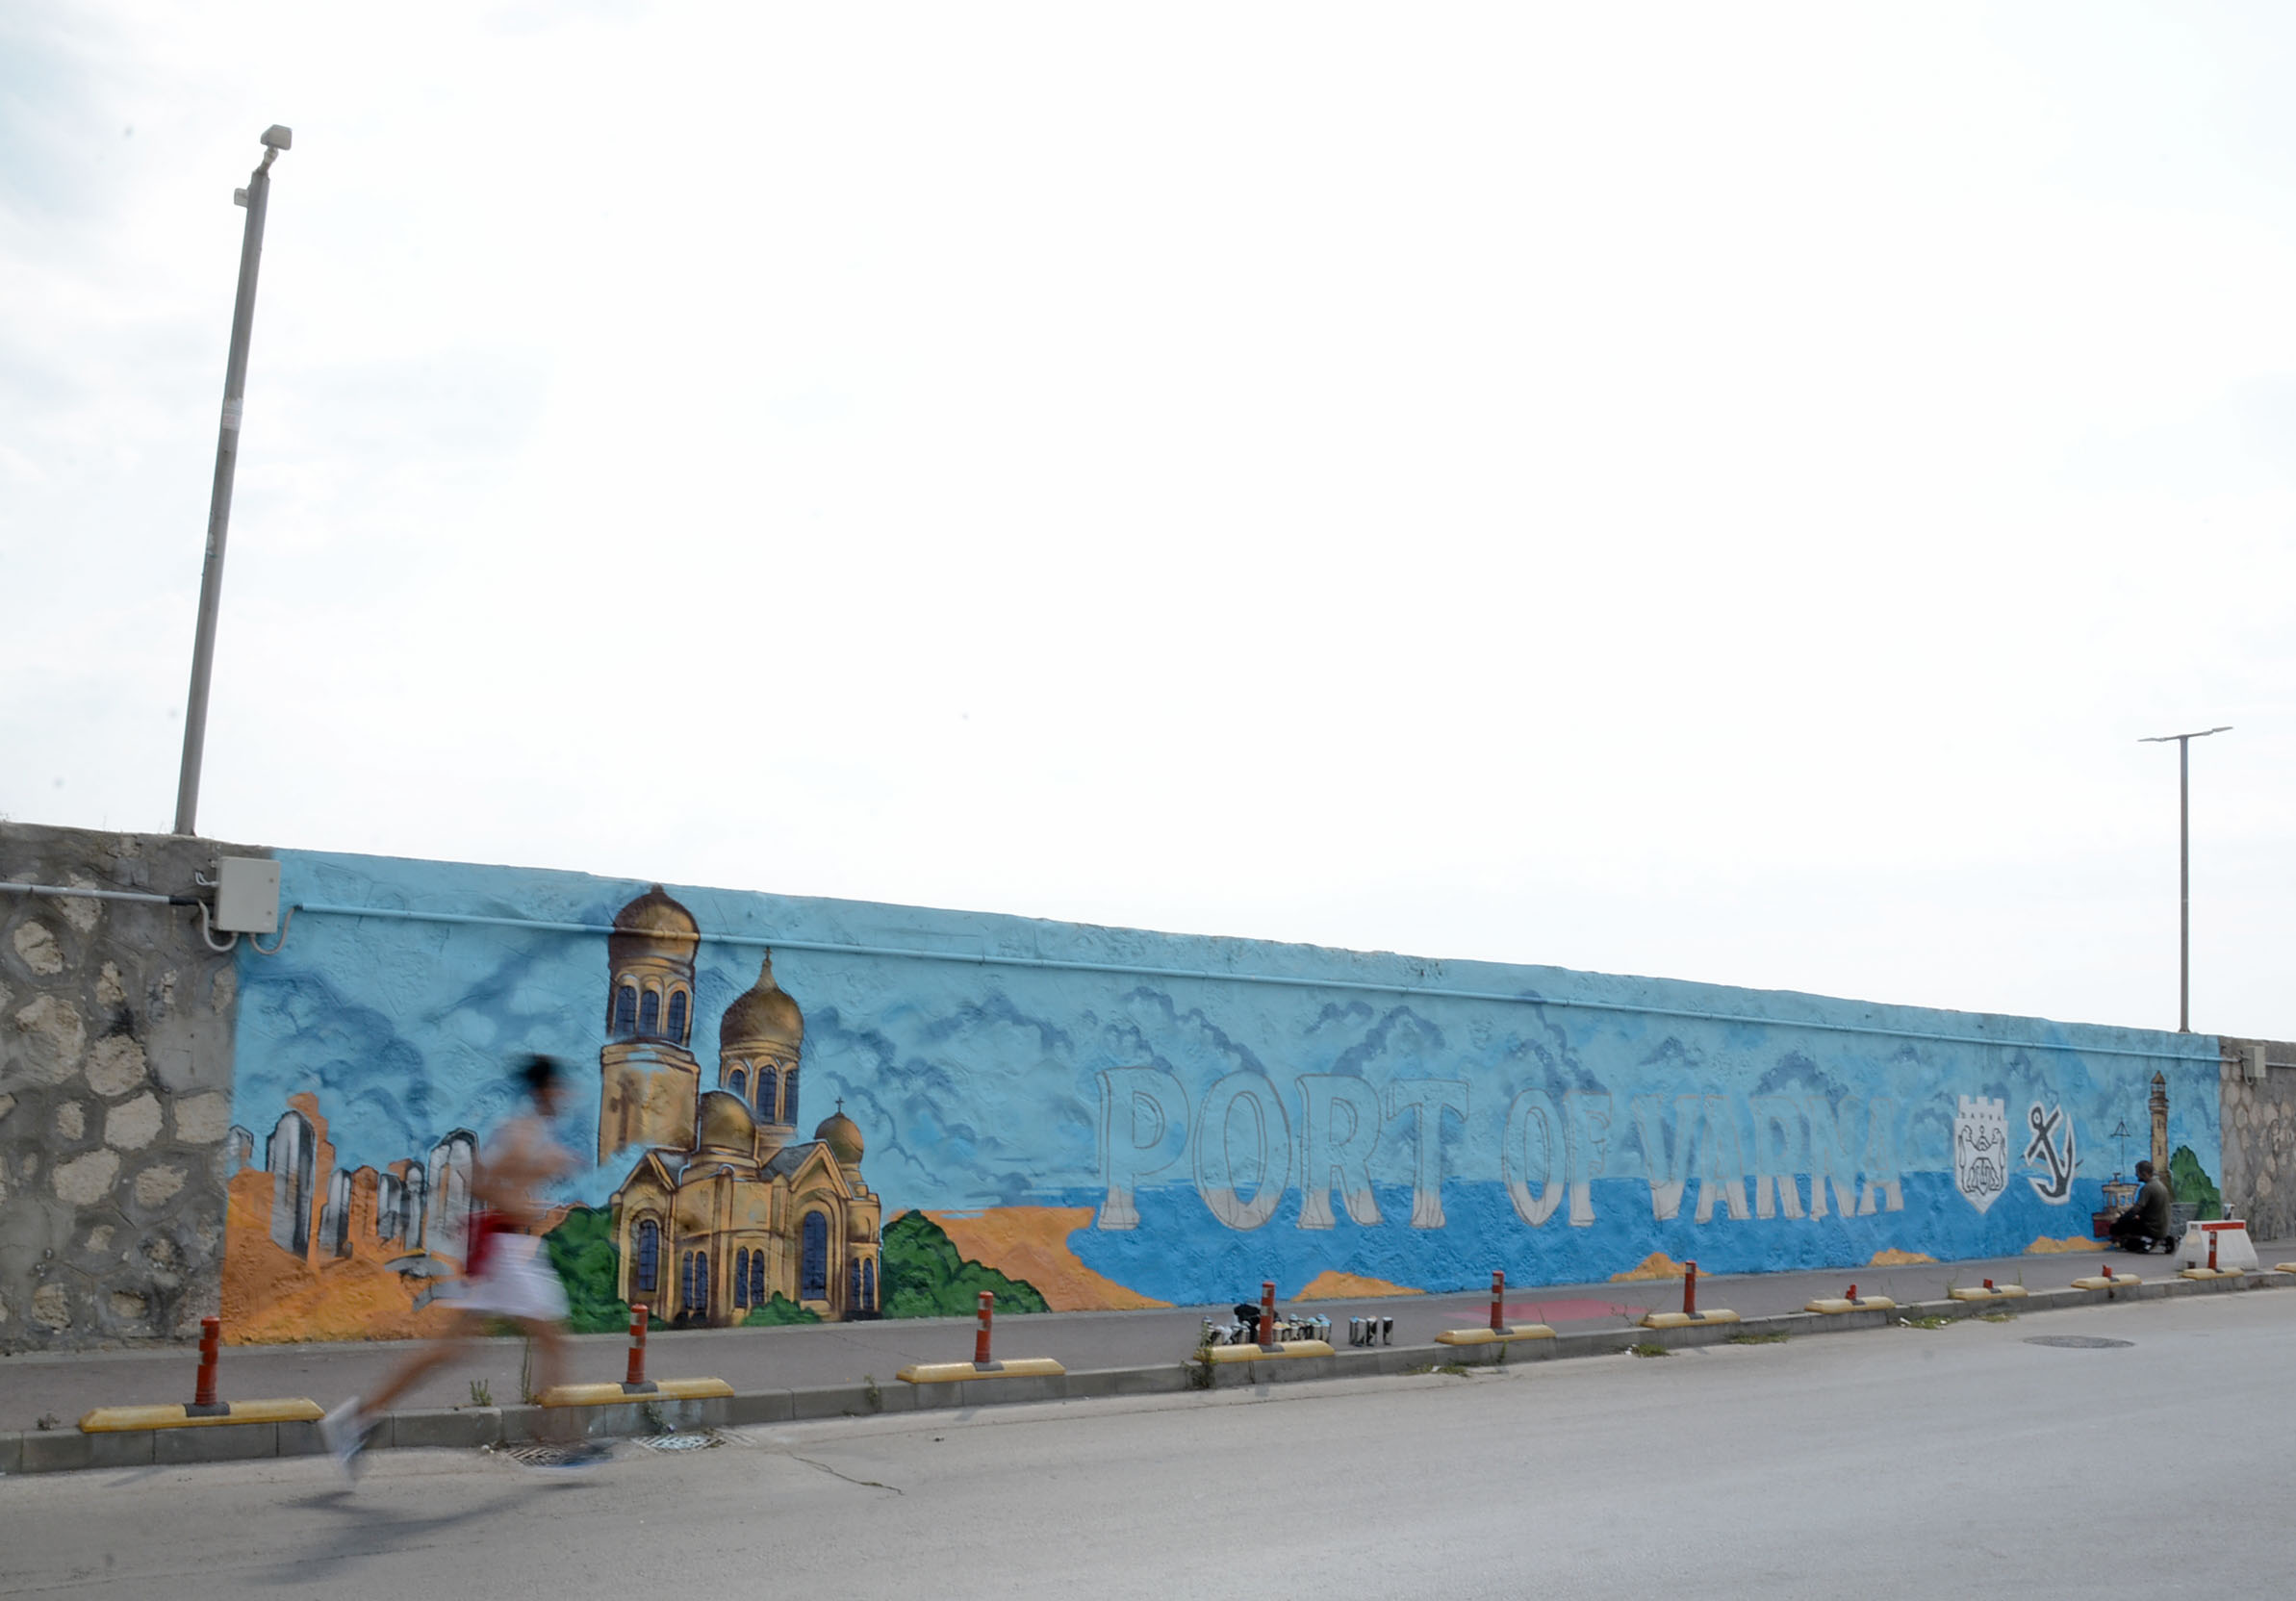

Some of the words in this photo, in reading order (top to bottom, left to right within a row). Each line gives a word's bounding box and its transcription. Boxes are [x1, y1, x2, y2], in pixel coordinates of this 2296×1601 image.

[1095, 1066, 1469, 1231] PORT
[1502, 1088, 1613, 1227] OF
[1632, 1094, 1903, 1223] VARNA
